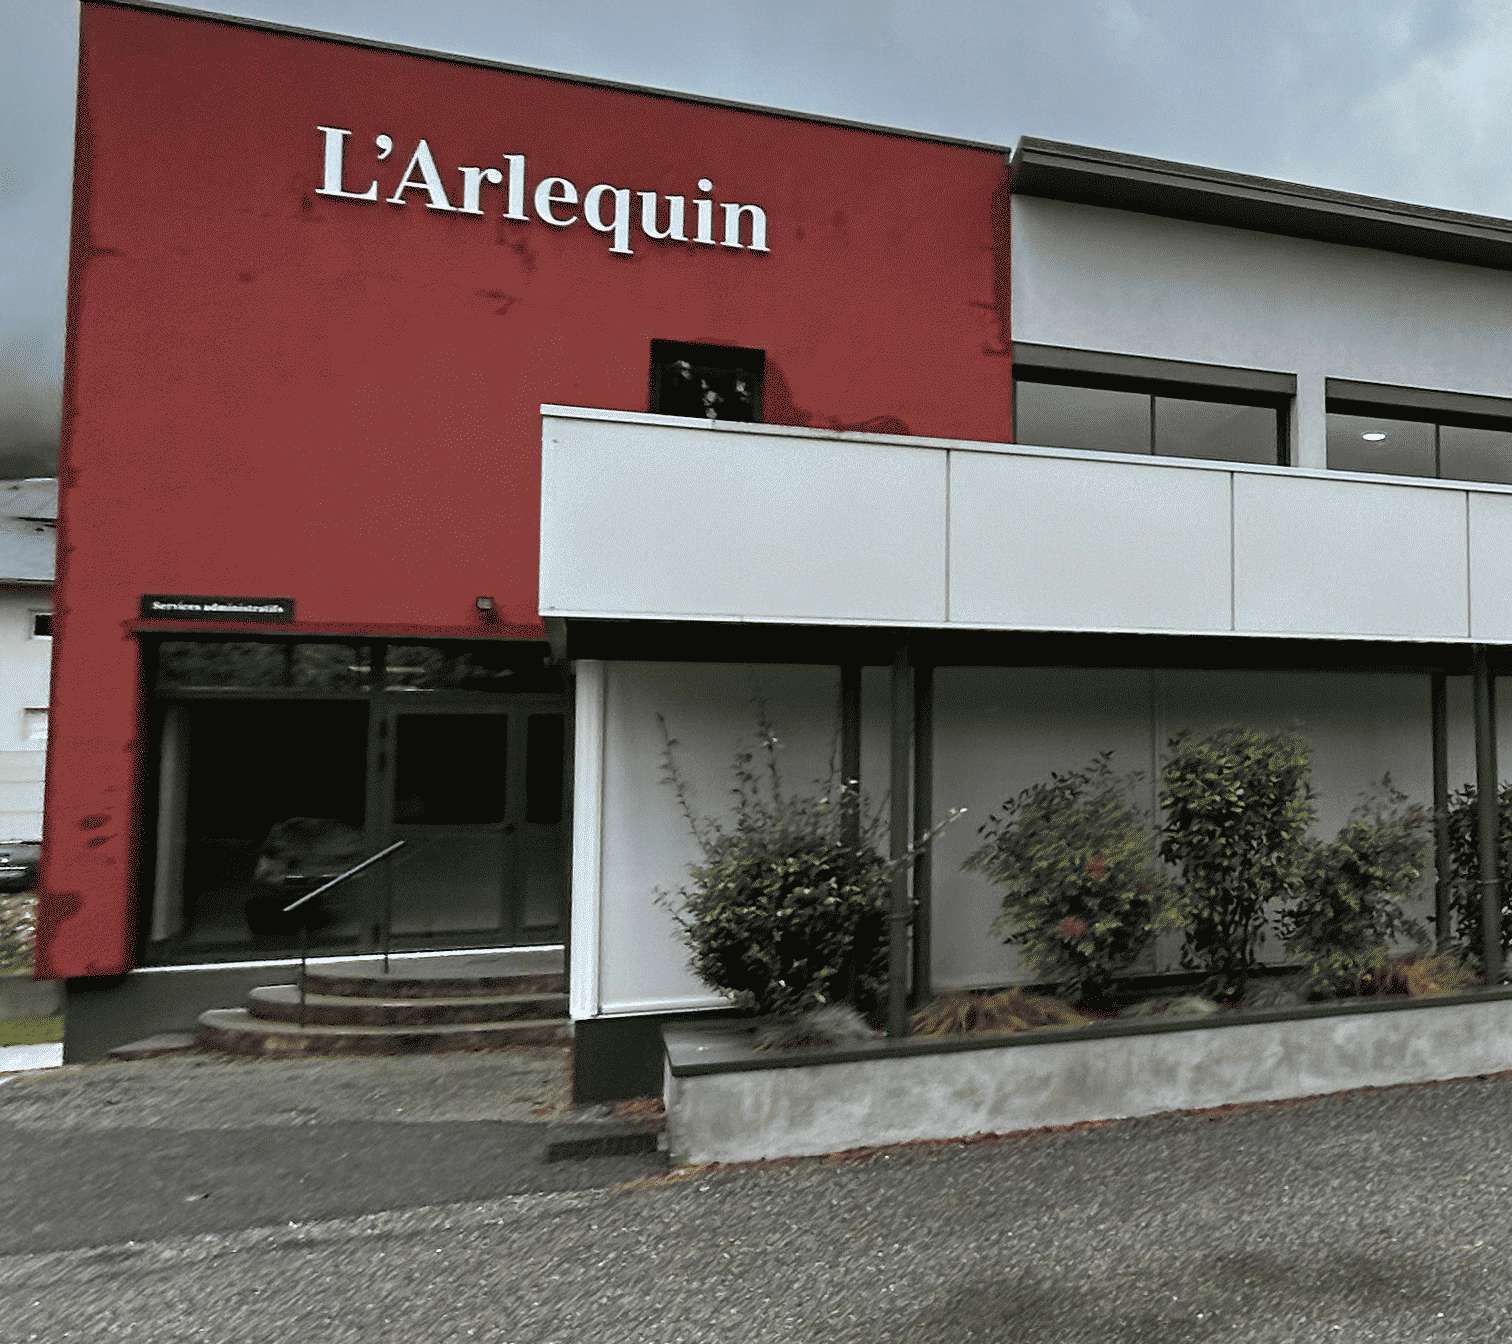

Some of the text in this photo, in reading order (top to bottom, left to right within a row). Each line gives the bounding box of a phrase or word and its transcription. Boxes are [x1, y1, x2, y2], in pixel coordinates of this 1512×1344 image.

[314, 124, 771, 255] L’Arlequin
[152, 600, 284, 613] Services administratifs
